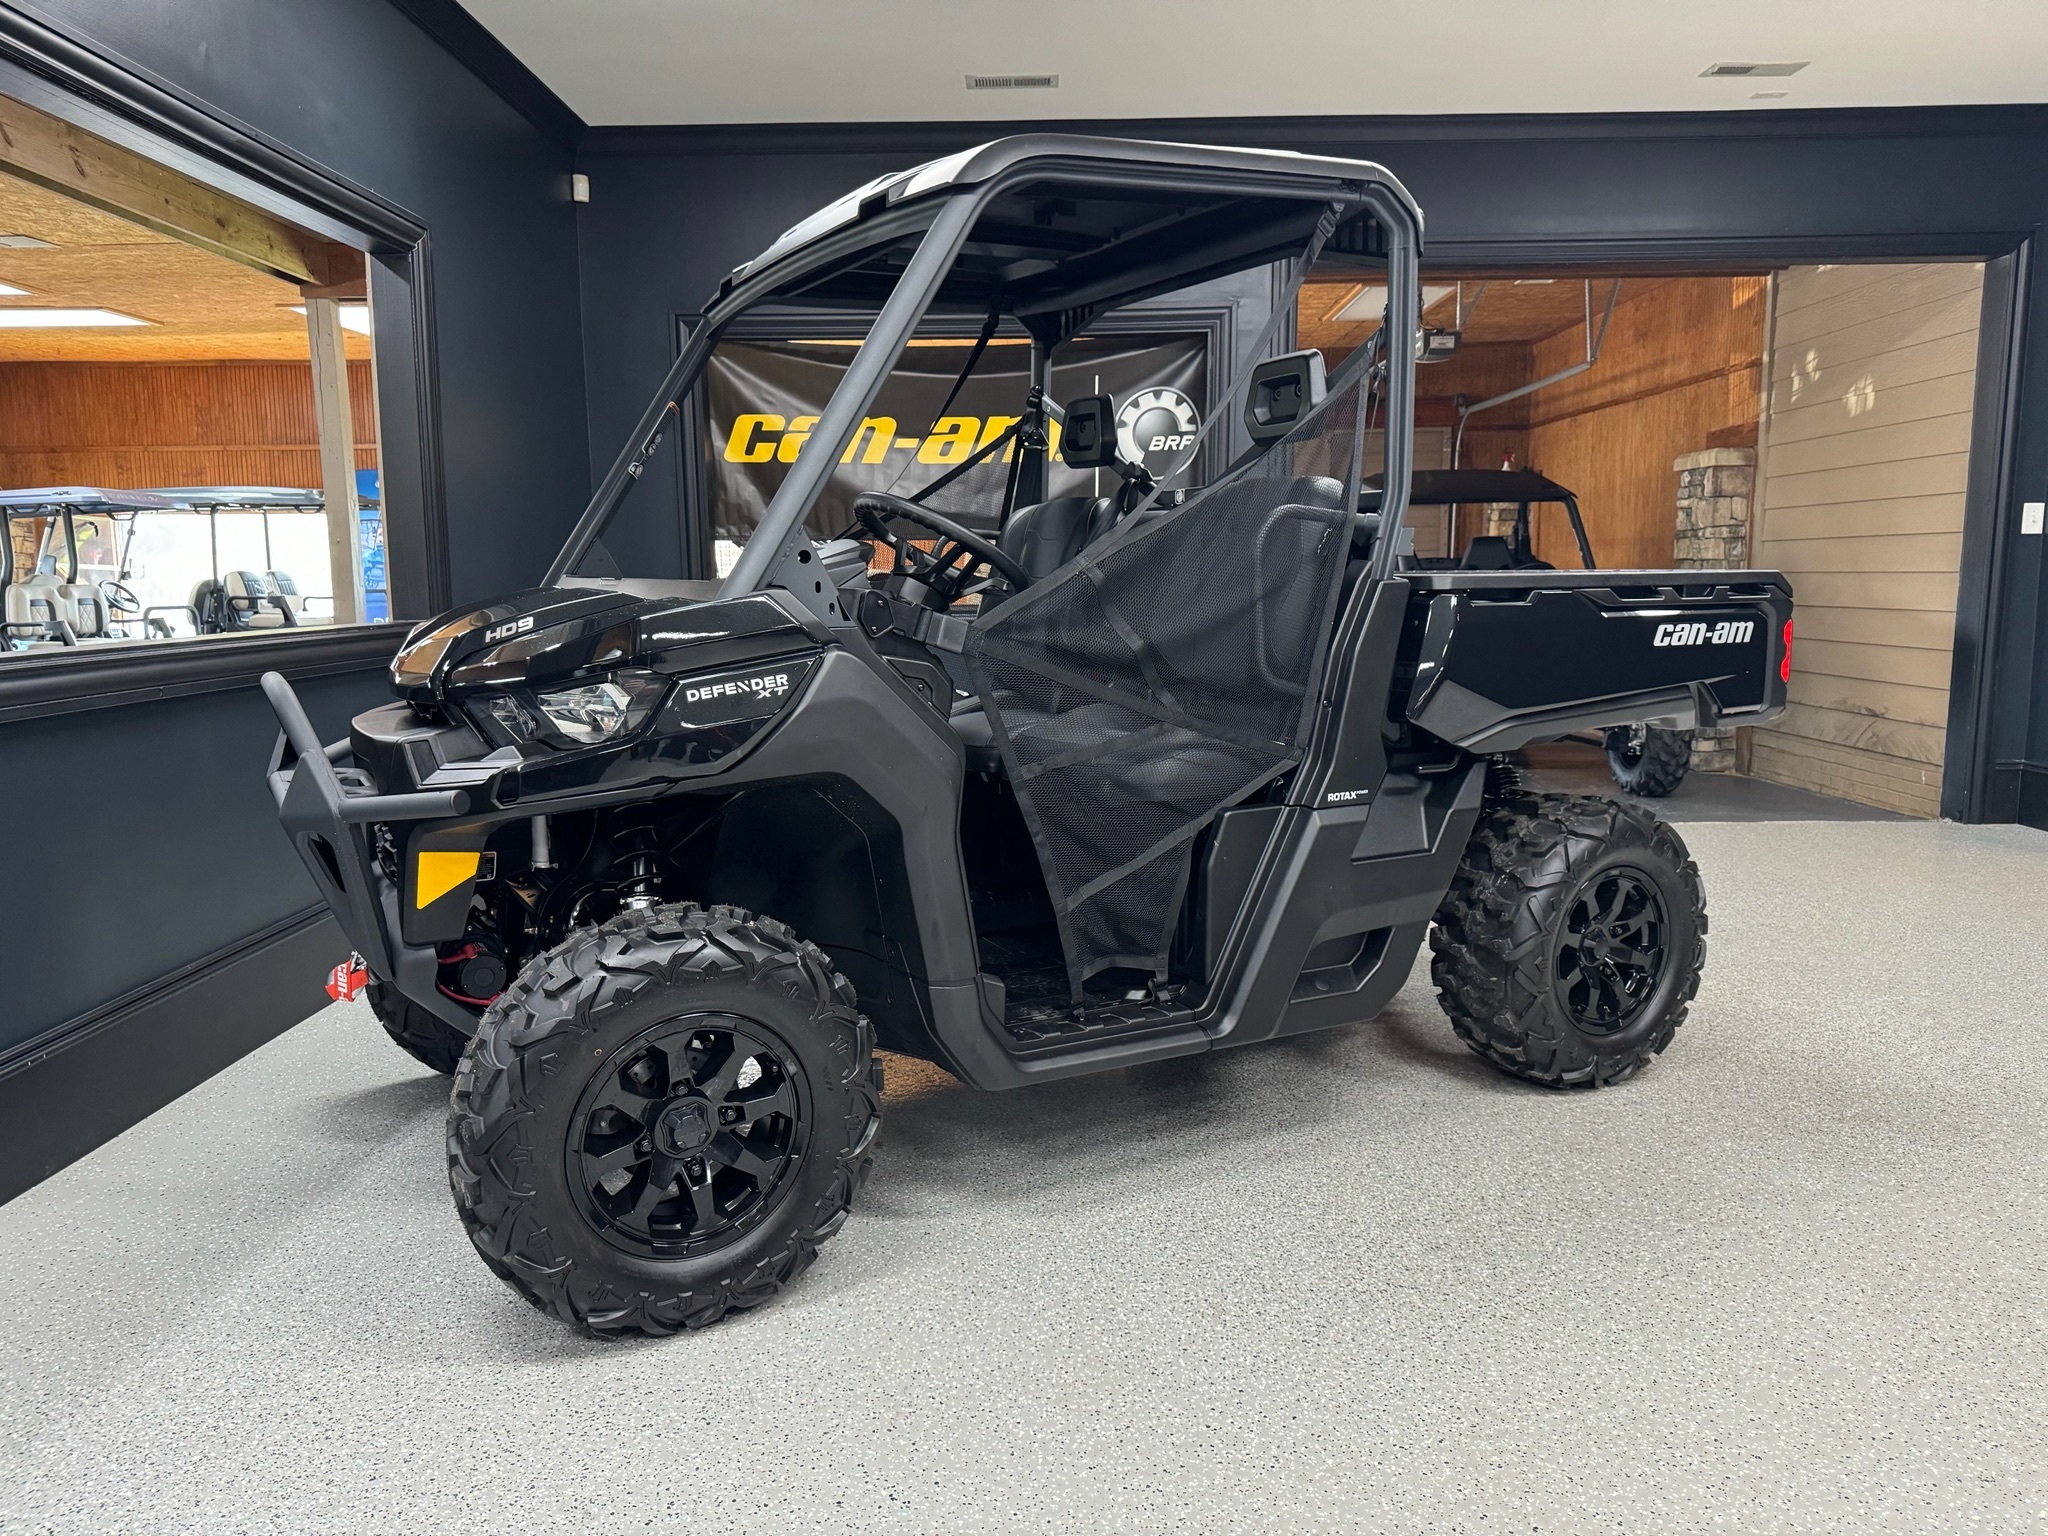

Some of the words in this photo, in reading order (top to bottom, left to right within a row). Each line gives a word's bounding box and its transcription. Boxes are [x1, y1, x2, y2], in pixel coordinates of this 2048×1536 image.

[1148, 435, 1197, 451] BRP
[485, 616, 534, 643] HD9
[1653, 621, 1754, 647] can-am
[686, 673, 789, 702] DEFENDER
[755, 685, 789, 700] XT
[1327, 791, 1357, 802] ROTAX
